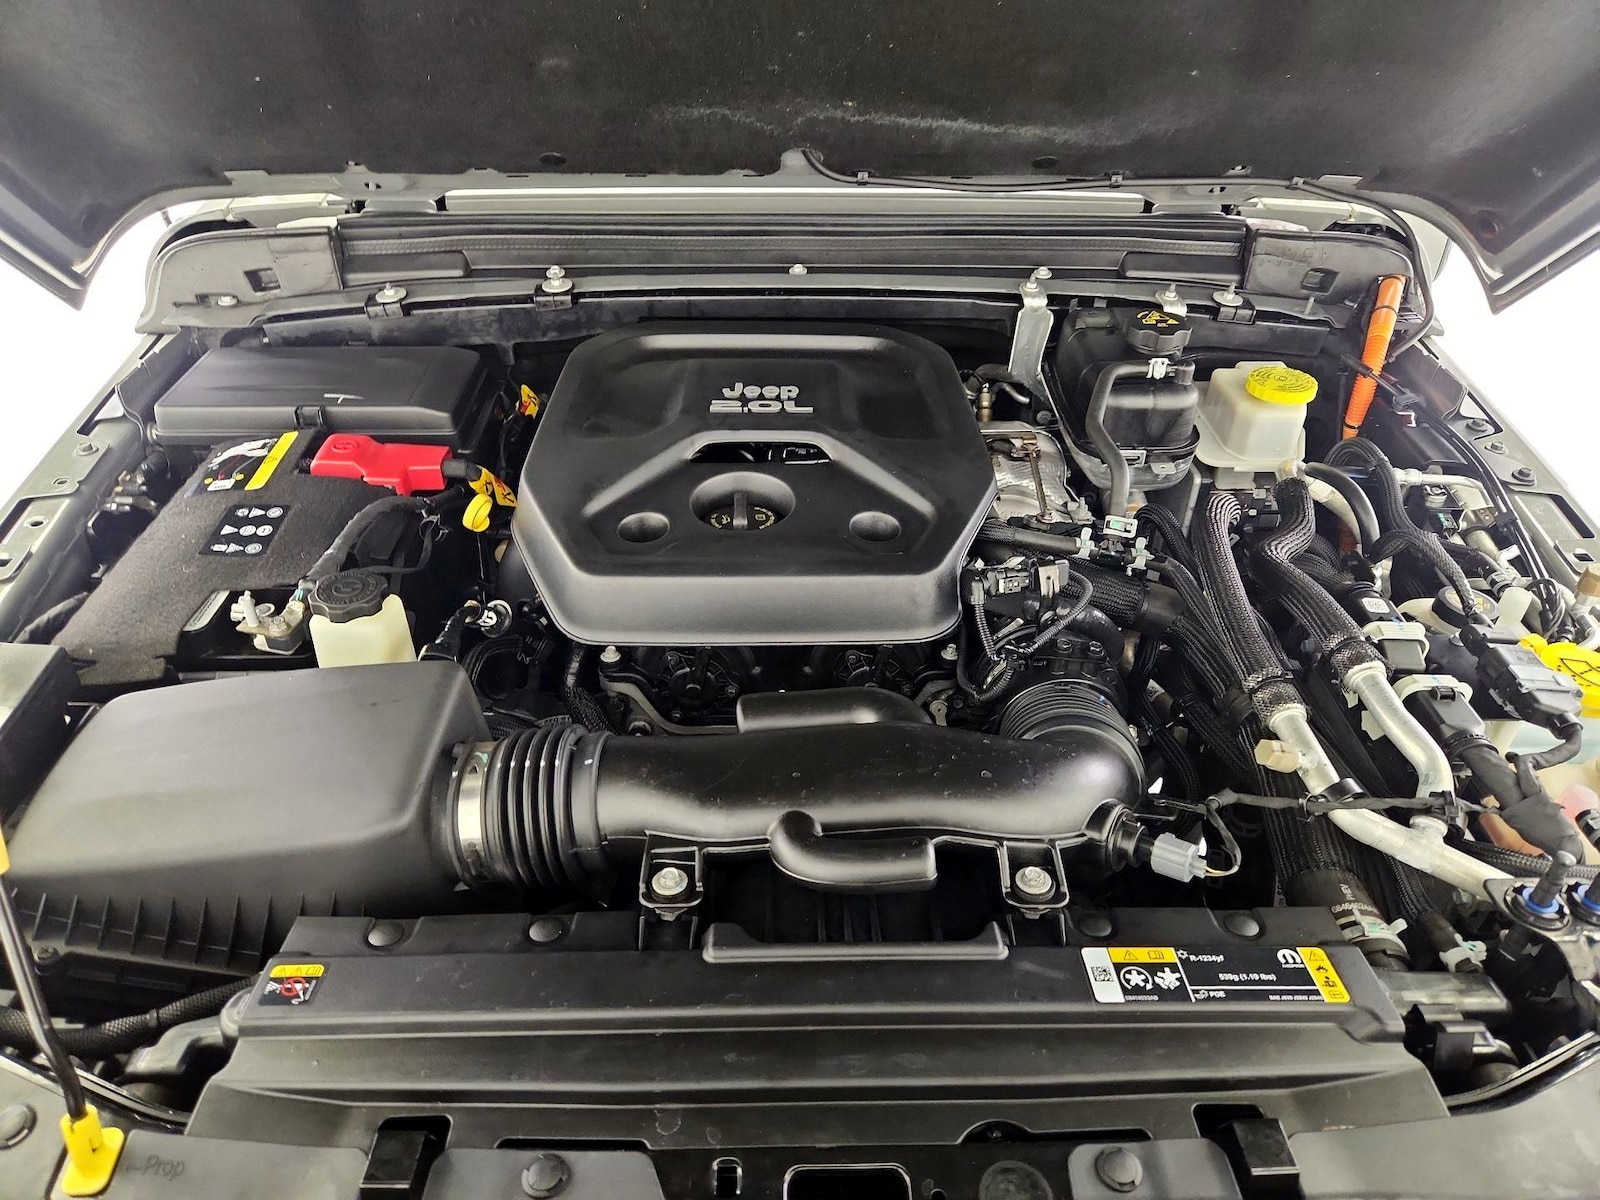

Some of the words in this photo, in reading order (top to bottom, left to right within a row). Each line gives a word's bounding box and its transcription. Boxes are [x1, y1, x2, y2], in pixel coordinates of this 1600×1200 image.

[722, 382, 800, 401] Jeep
[709, 400, 814, 414] 2.0L
[1189, 954, 1225, 964] R-1234yf
